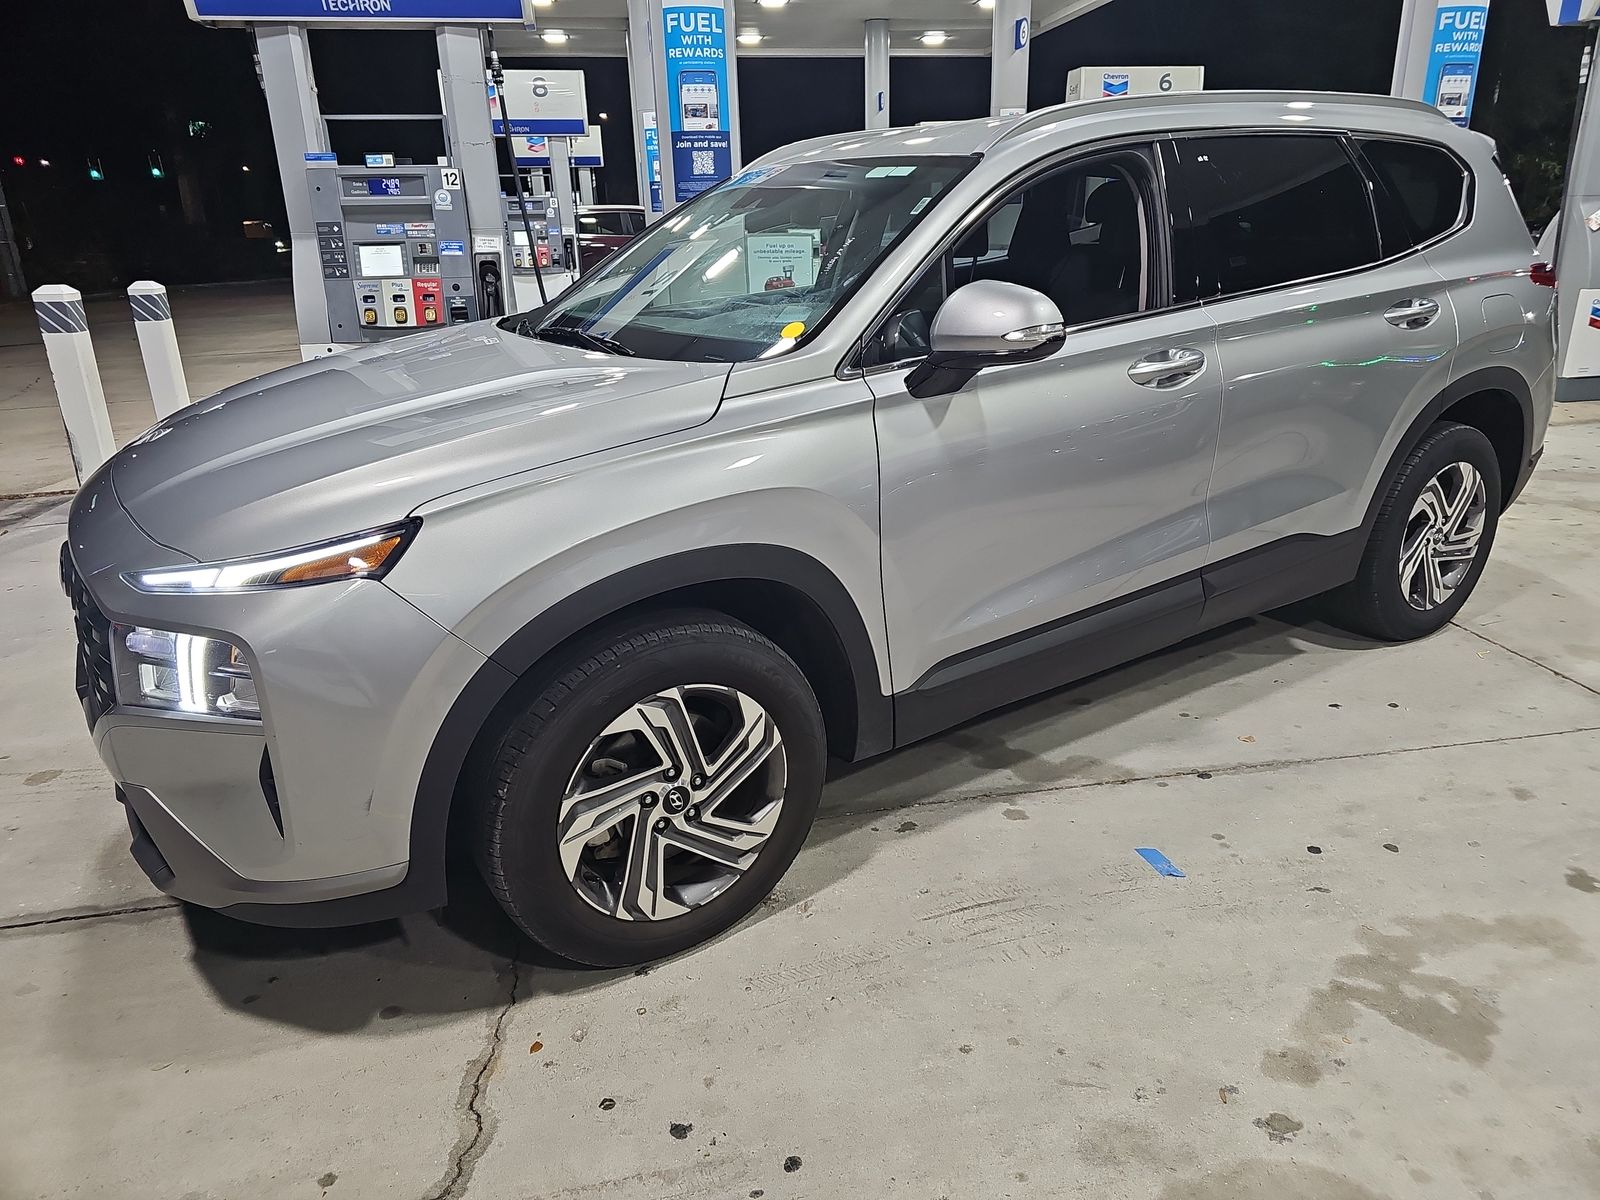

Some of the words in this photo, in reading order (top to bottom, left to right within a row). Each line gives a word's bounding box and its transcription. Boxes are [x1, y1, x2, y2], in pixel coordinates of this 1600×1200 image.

[666, 12, 723, 33] FUEL
[680, 35, 712, 46] WITH
[1452, 31, 1478, 41] WITH
[668, 47, 724, 59] REWARDS
[532, 76, 549, 98] 8
[1159, 72, 1172, 92] 6
[676, 140, 692, 149] Join
[693, 140, 709, 148] and
[710, 140, 728, 148] save!
[443, 172, 459, 186] 12
[357, 281, 379, 290] Supreme
[416, 281, 438, 289] Regular
